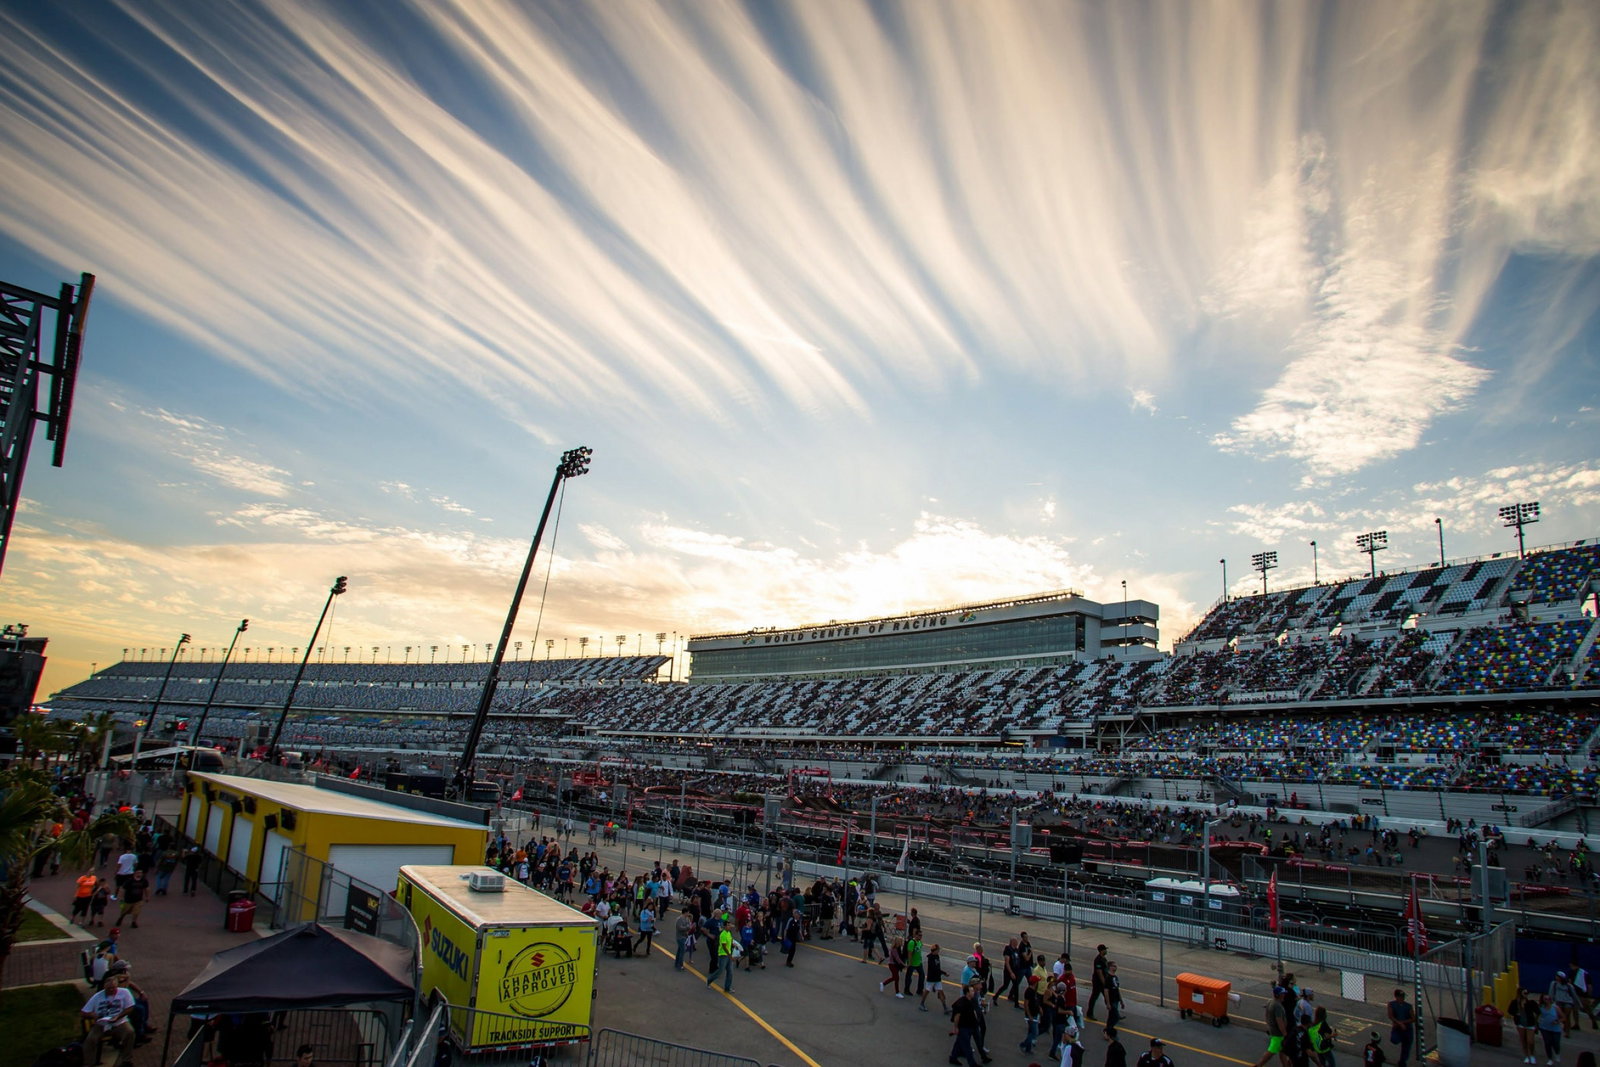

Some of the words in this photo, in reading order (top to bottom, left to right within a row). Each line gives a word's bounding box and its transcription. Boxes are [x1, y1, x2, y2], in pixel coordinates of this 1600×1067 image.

[764, 633, 804, 644] WORLD
[811, 626, 860, 640] CENTER
[868, 623, 885, 634] OF
[893, 616, 948, 631] RACING
[431, 927, 469, 982] SUZUKI
[502, 963, 575, 990] CHAMPION
[502, 972, 576, 1000] APPROVED
[489, 1028, 537, 1042] TRACKSIDE
[539, 1025, 576, 1038] SUPPORT
